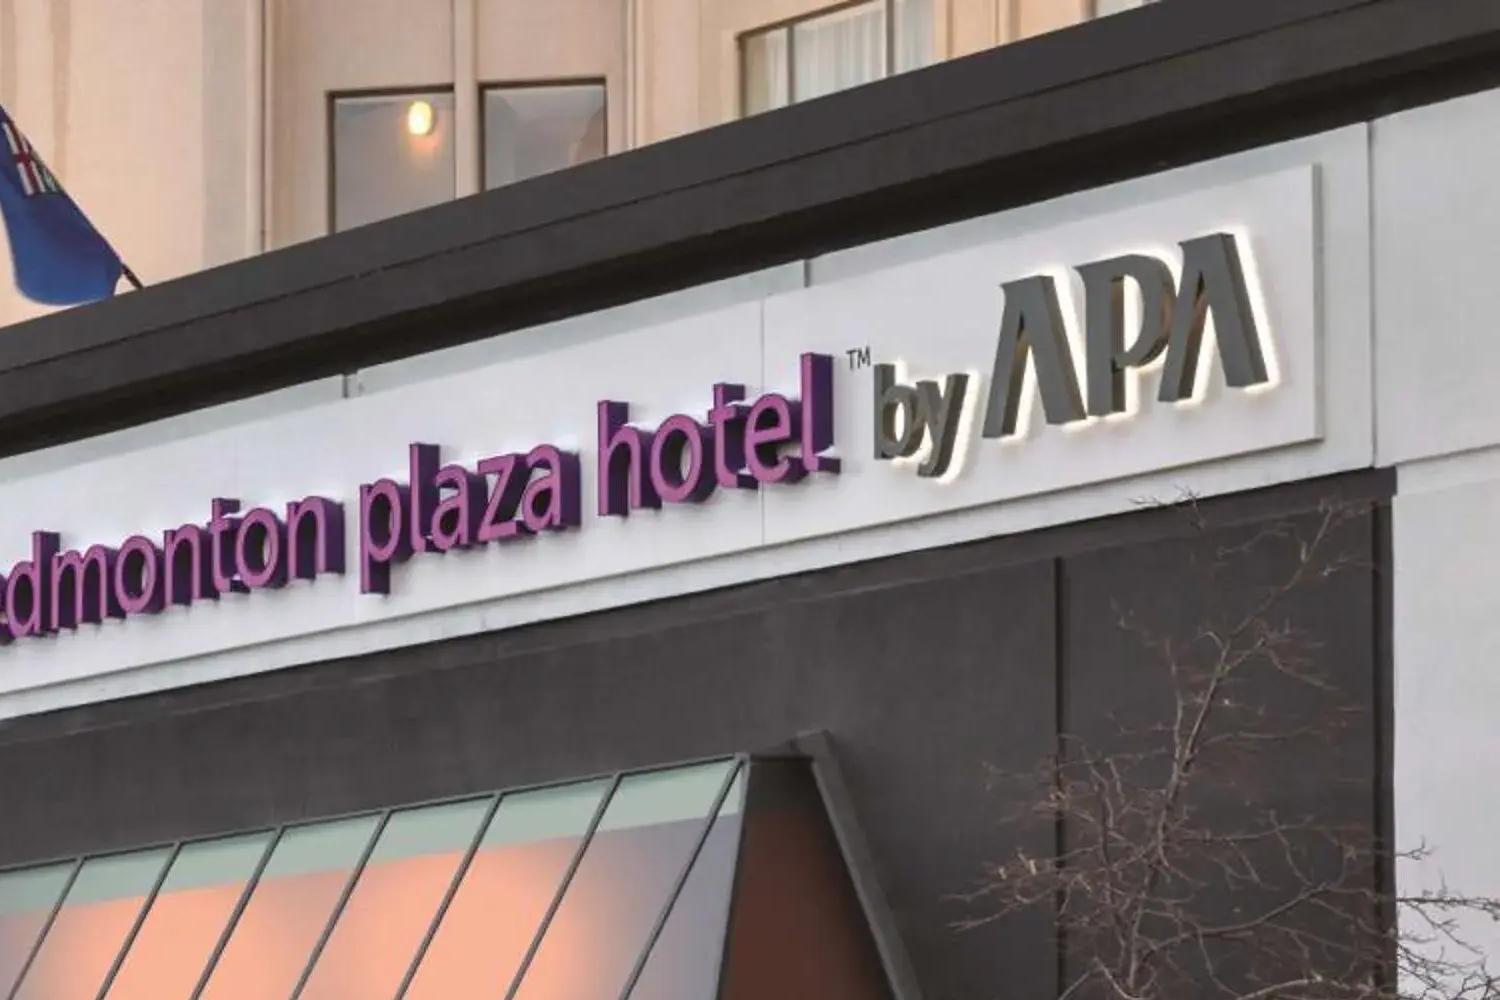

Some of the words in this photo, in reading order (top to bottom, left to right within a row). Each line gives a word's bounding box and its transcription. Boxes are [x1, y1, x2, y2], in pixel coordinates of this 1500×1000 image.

[360, 442, 581, 595] plaza
[597, 352, 840, 517] hotel
[874, 362, 969, 478] by
[983, 232, 1270, 438] APA
